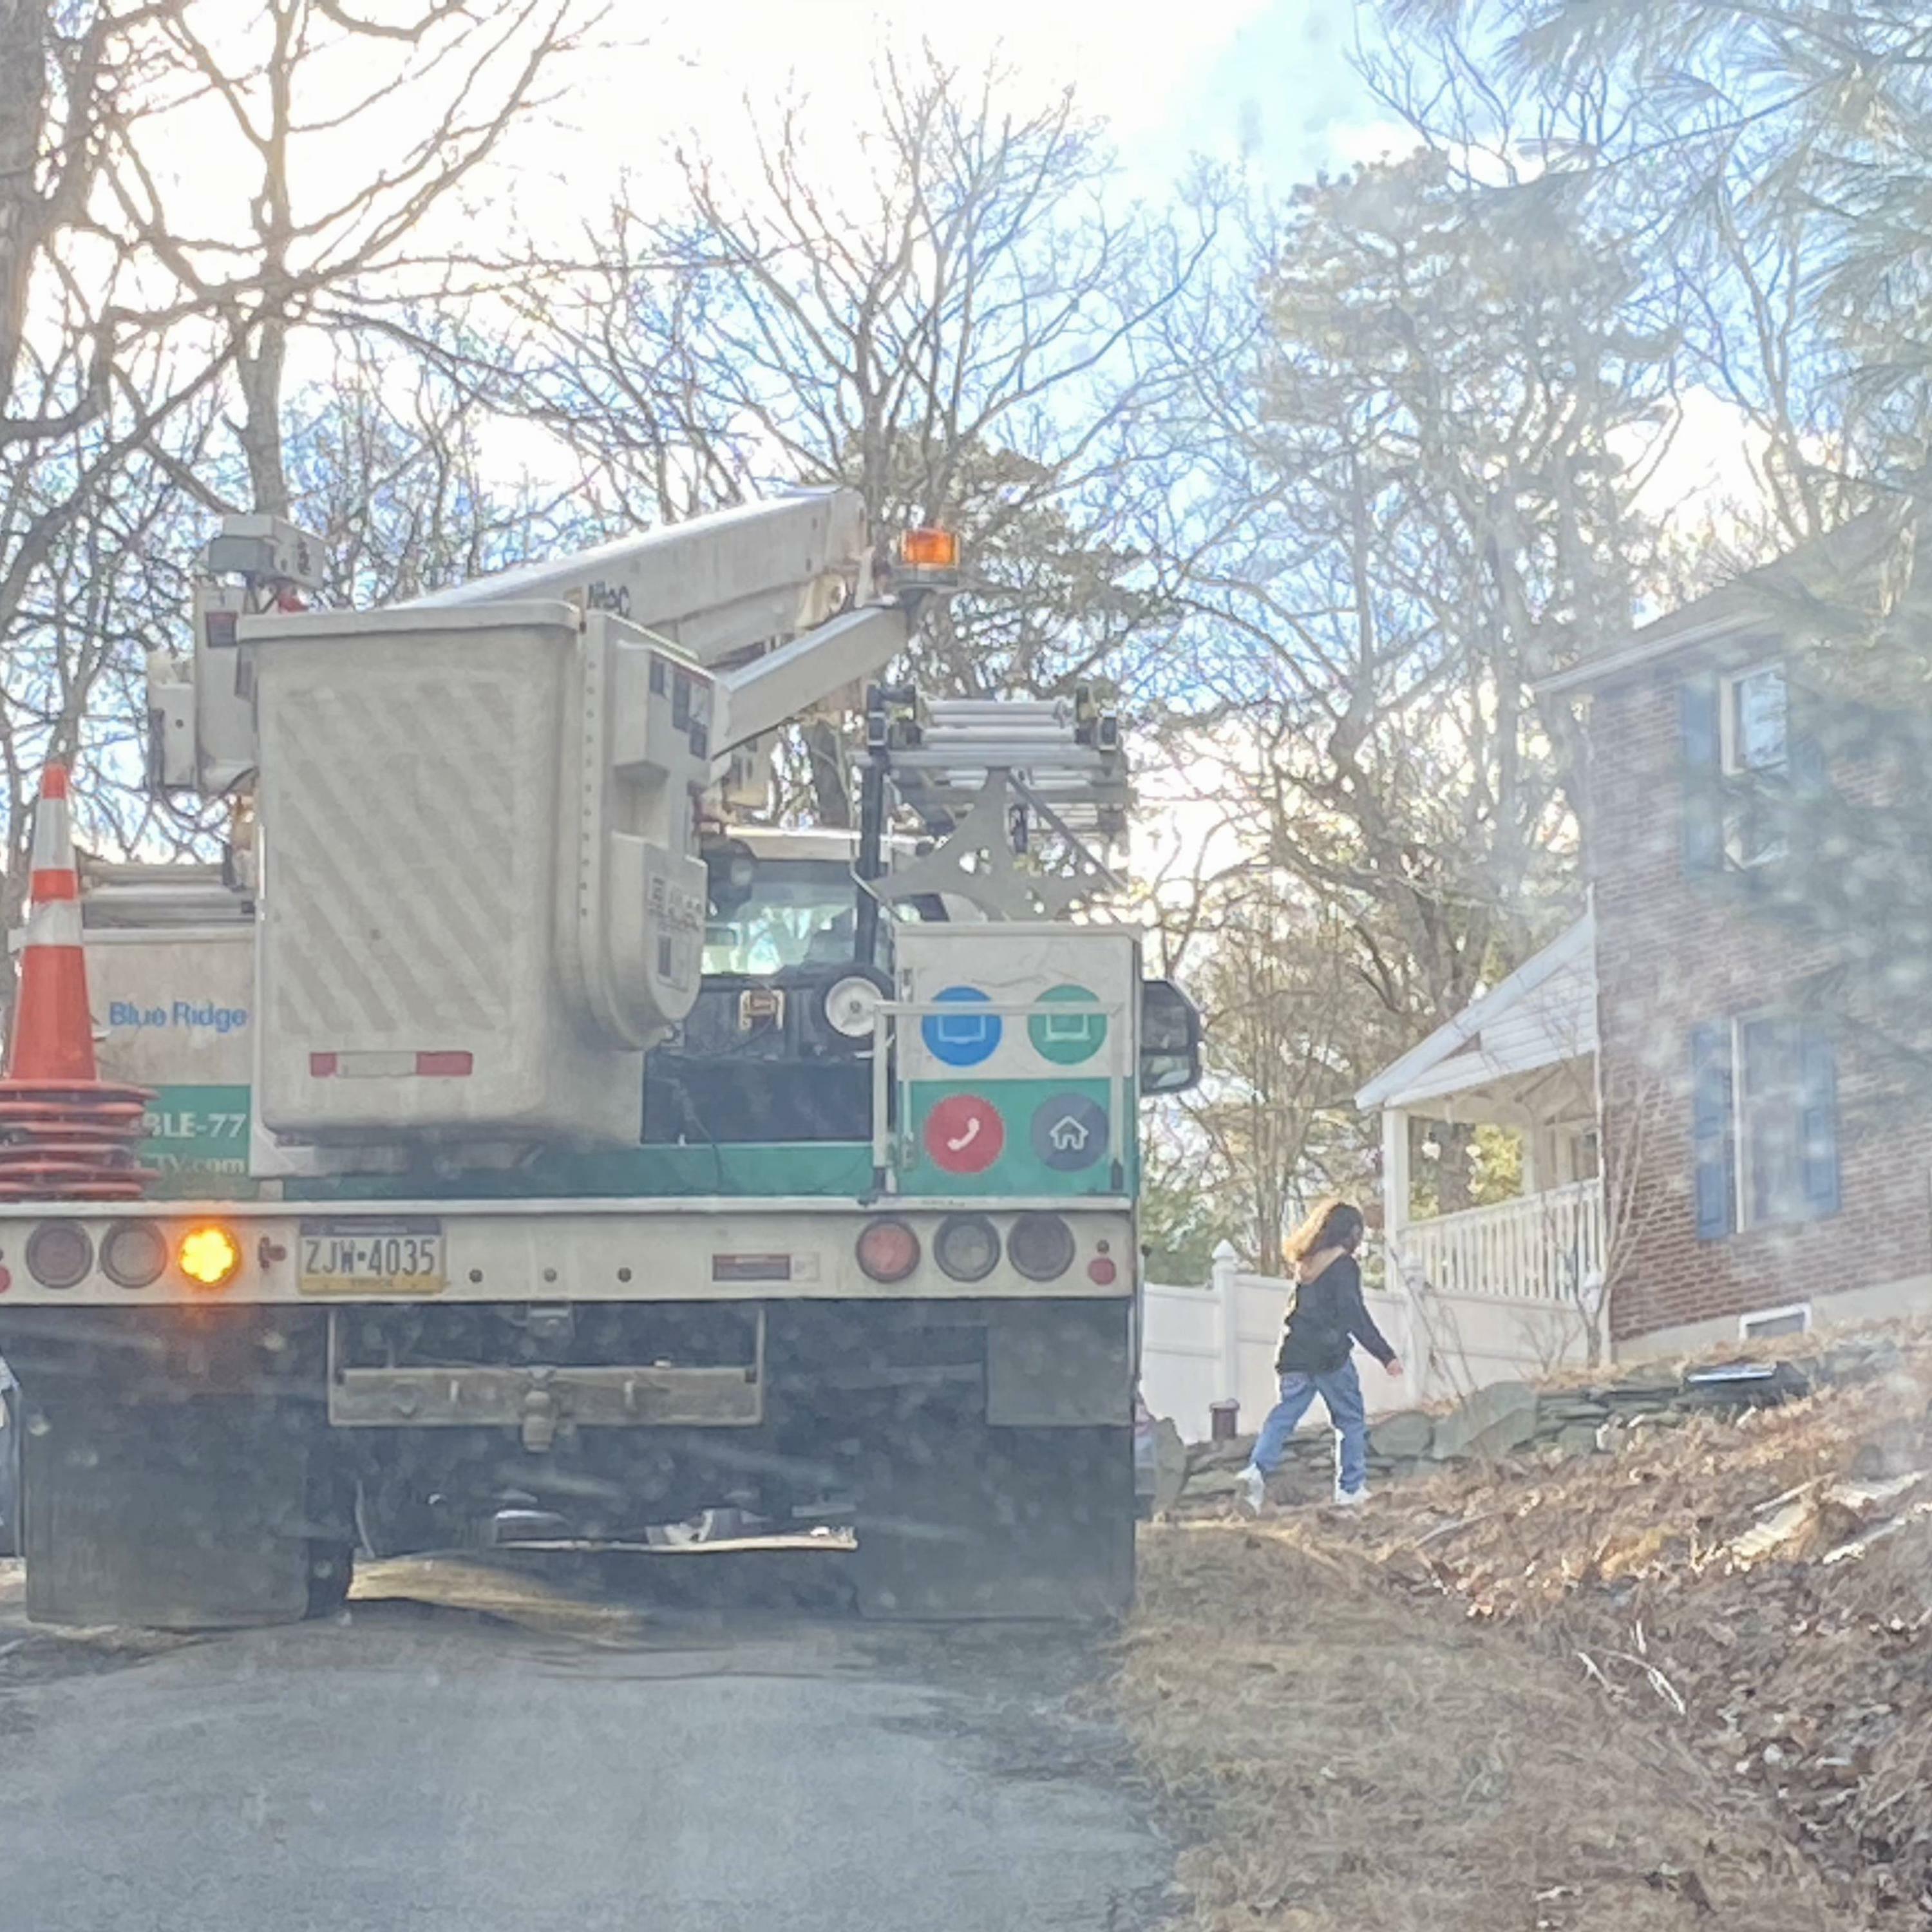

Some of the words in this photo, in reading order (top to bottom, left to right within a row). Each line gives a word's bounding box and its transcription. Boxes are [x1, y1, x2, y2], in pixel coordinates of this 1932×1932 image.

[109, 1001, 167, 1027] Blue
[172, 999, 247, 1033] Ridge
[132, 1112, 246, 1139] BLE-77
